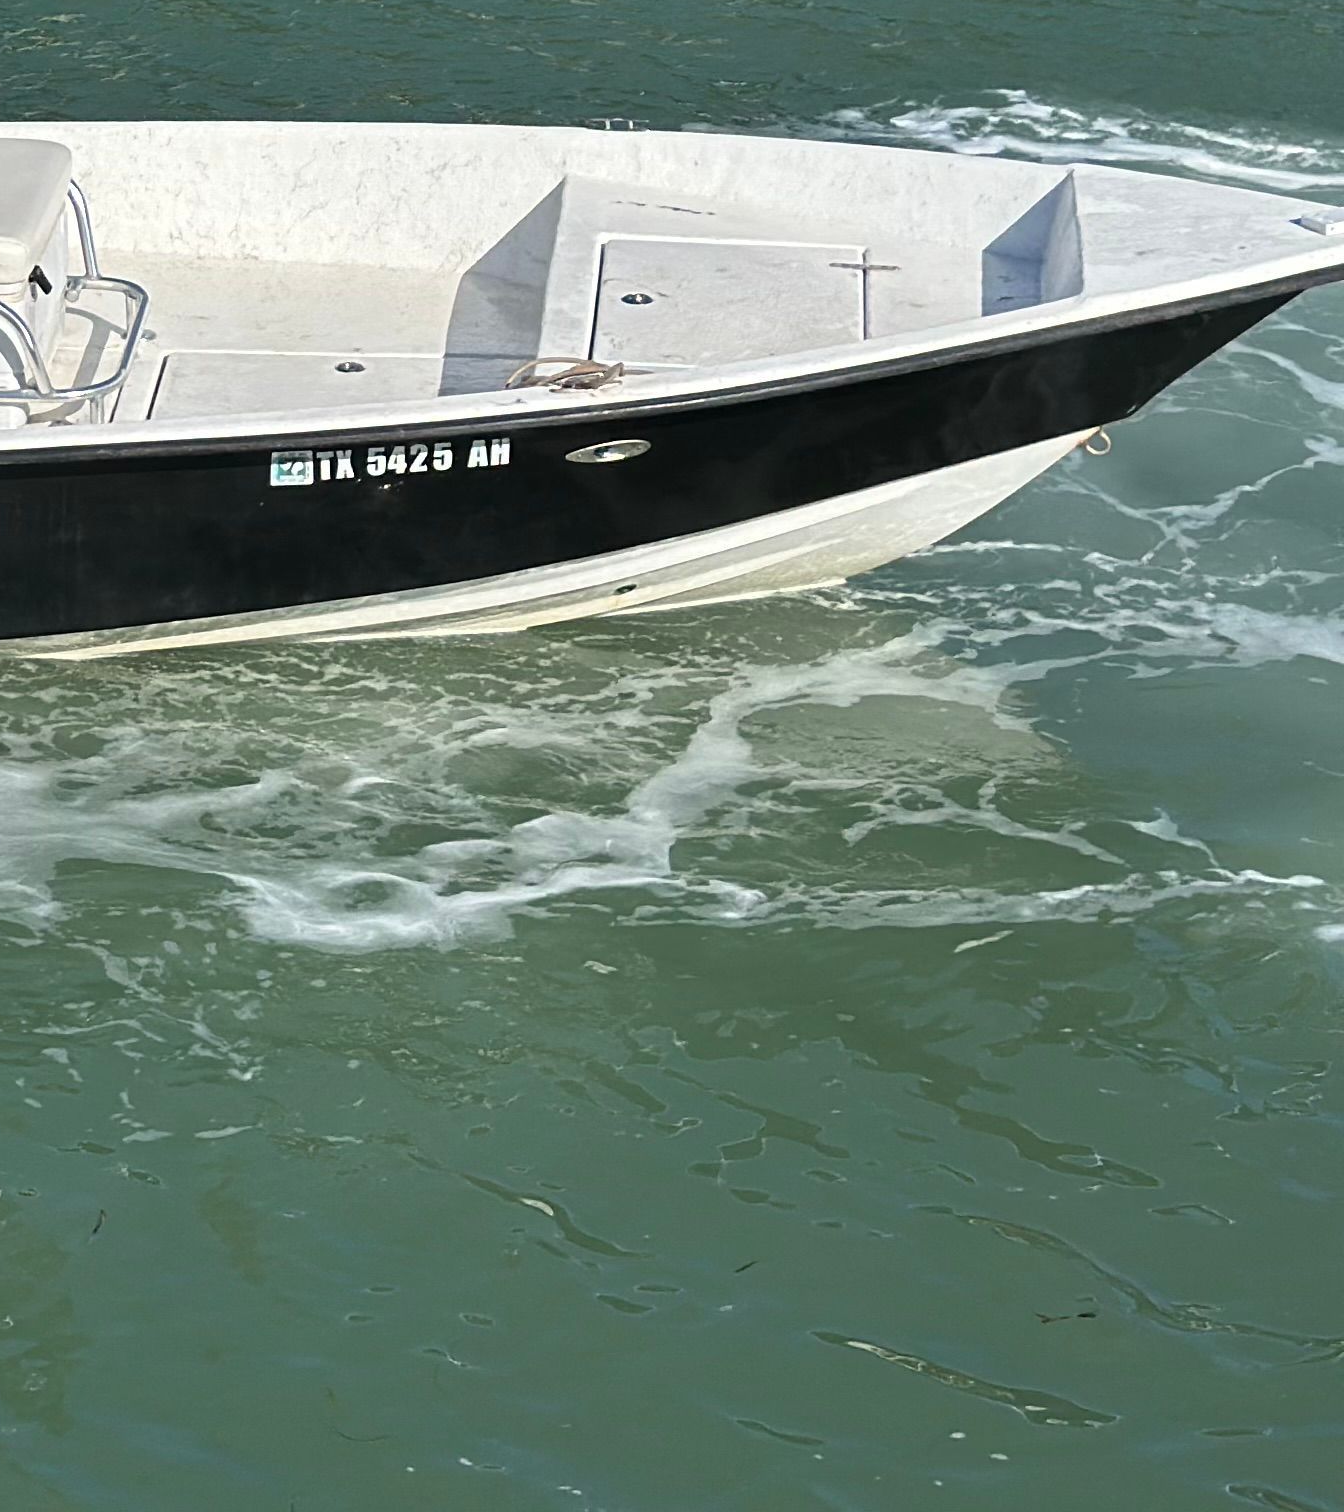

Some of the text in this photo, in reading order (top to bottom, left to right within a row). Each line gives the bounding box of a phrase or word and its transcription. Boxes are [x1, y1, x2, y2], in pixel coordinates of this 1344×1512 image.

[316, 449, 355, 481] TX
[366, 442, 454, 477] 5425
[466, 437, 511, 469] AH
